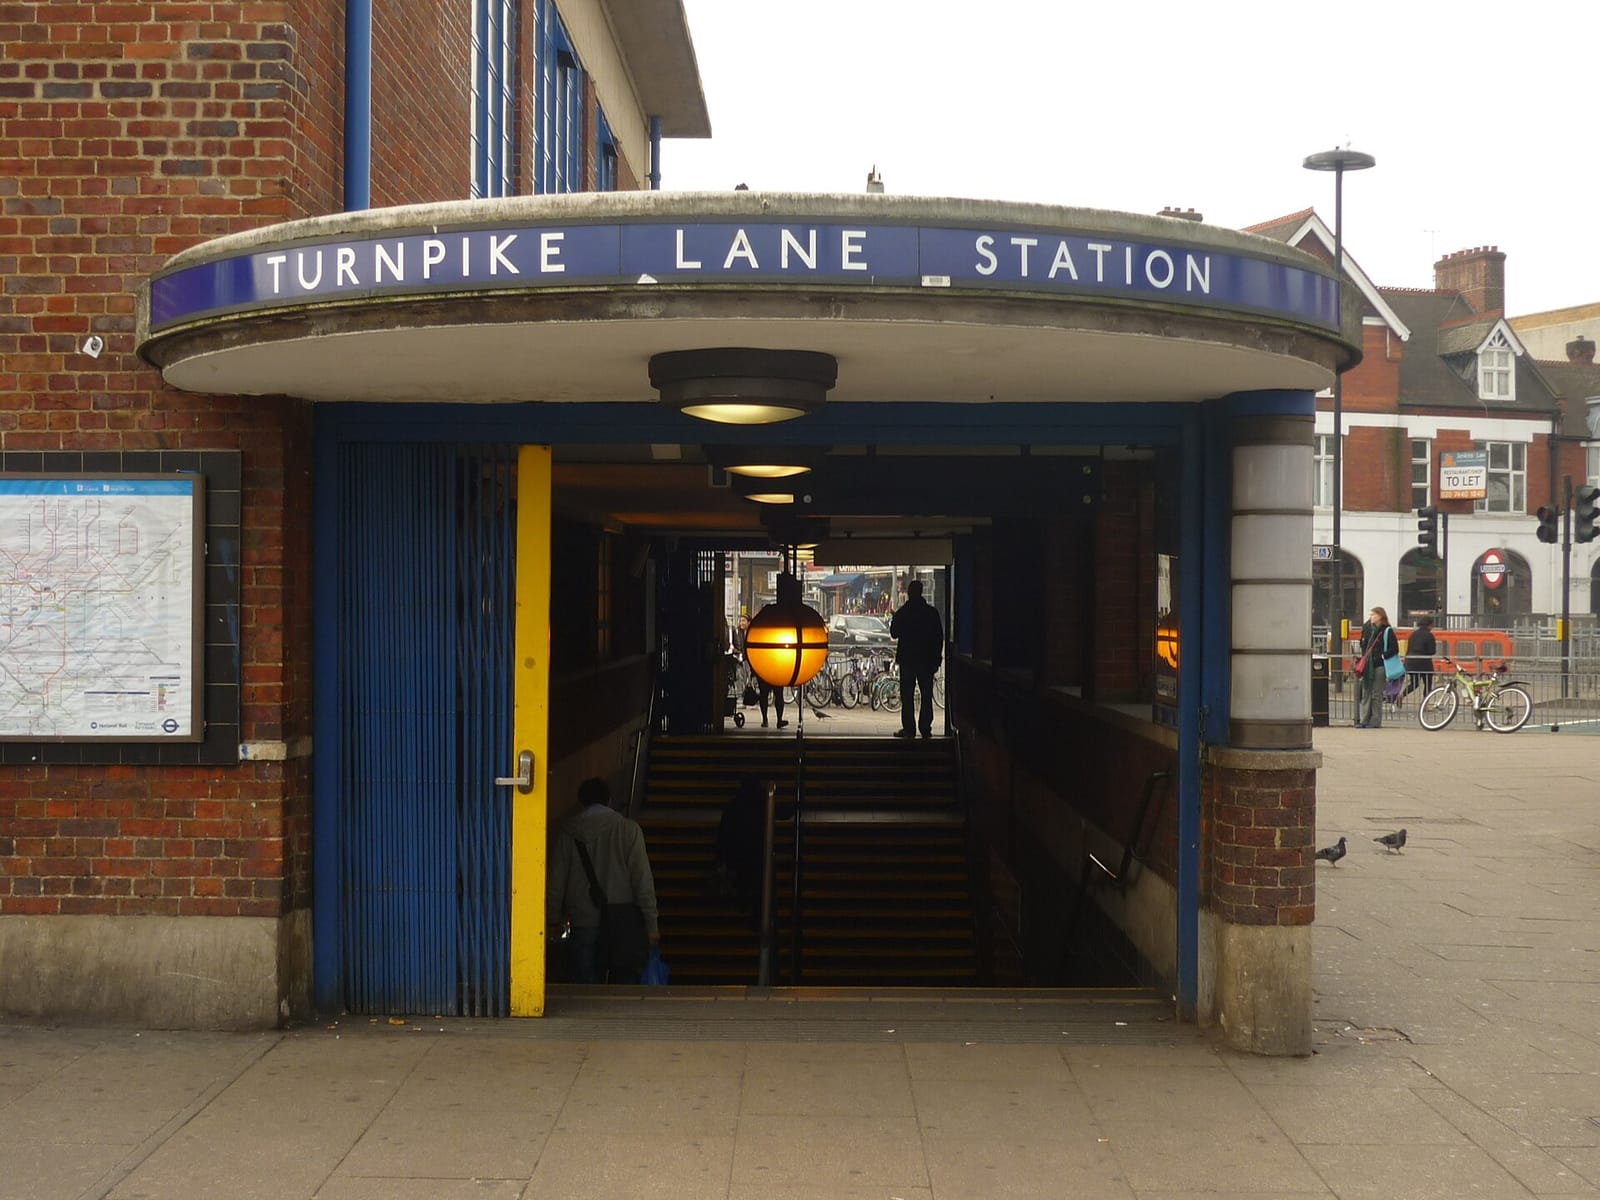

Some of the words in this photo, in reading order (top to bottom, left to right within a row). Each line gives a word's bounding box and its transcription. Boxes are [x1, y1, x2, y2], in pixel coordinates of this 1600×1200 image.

[266, 232, 566, 294] TURNPIKE
[676, 229, 868, 270] LANE
[975, 235, 1211, 294] STATION
[1446, 476, 1459, 487] TO
[1462, 476, 1481, 486] LET
